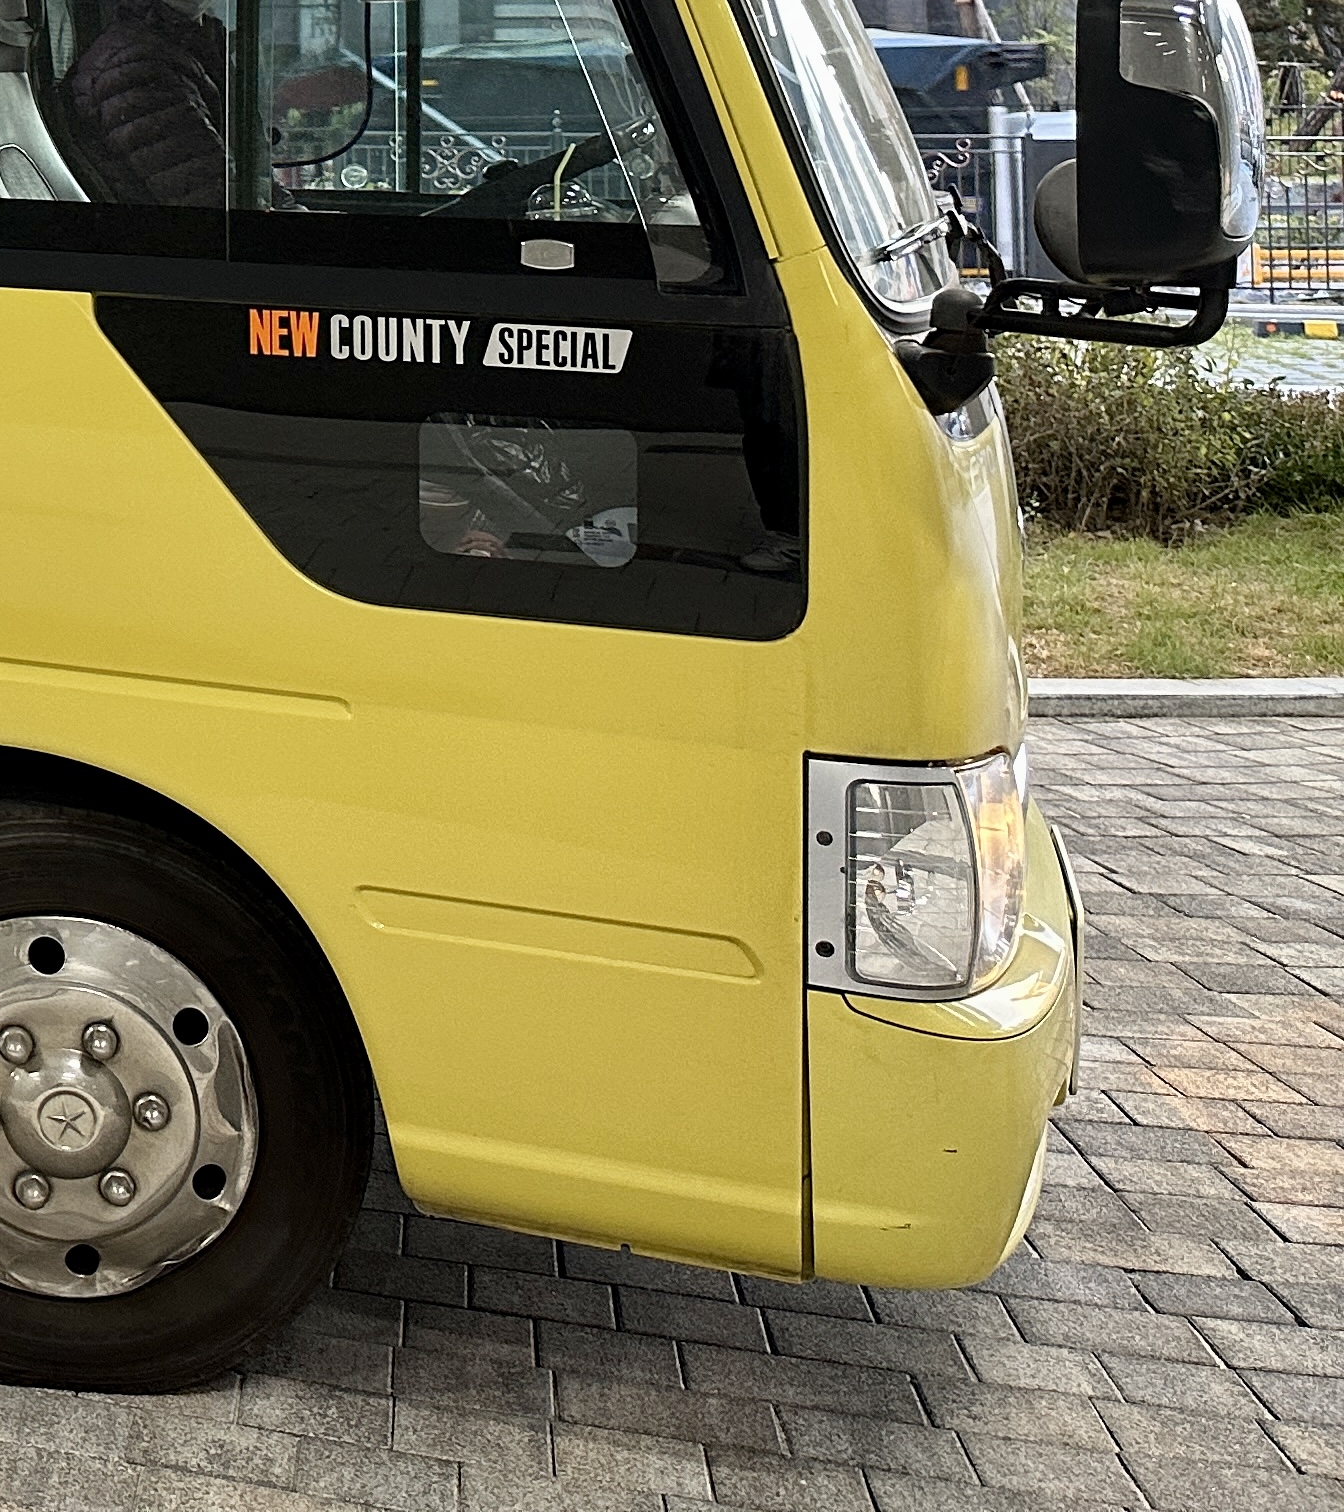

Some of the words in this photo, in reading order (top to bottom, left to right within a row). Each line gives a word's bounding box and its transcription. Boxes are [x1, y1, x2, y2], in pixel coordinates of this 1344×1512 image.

[249, 308, 320, 358] NEW
[330, 314, 471, 365] COUNTY
[498, 326, 616, 371] SPECIAL
